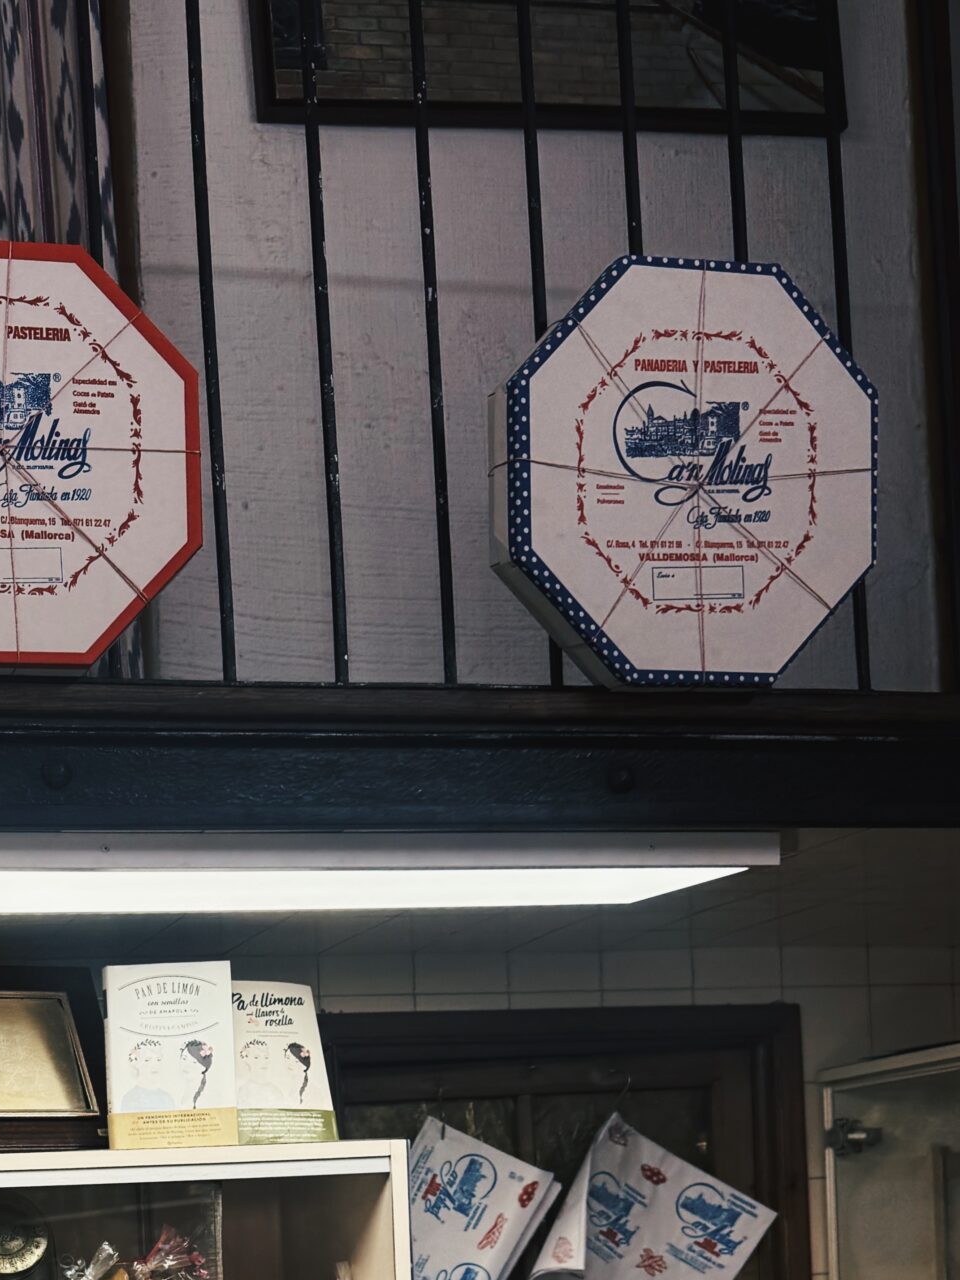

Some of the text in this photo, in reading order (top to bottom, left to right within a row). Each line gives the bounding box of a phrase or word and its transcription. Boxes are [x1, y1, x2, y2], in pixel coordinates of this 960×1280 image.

[6, 325, 71, 341] PASTELERIA
[634, 359, 759, 374] PANADERIA Y PASTELERIA
[10, 411, 93, 480] Molinas
[60, 492, 70, 501] en
[70, 488, 92, 502] 1920
[49, 517, 56, 526] 15
[752, 509, 771, 523] 1920
[21, 530, 75, 542] (Mallorca)
[638, 552, 759, 563] VALLDEMOSSA (Mallorca)
[134, 984, 153, 1000] PAN
[156, 982, 168, 995] DE
[249, 994, 259, 1007] de
[260, 992, 305, 1008] llimona
[265, 1014, 294, 1027] rosella
